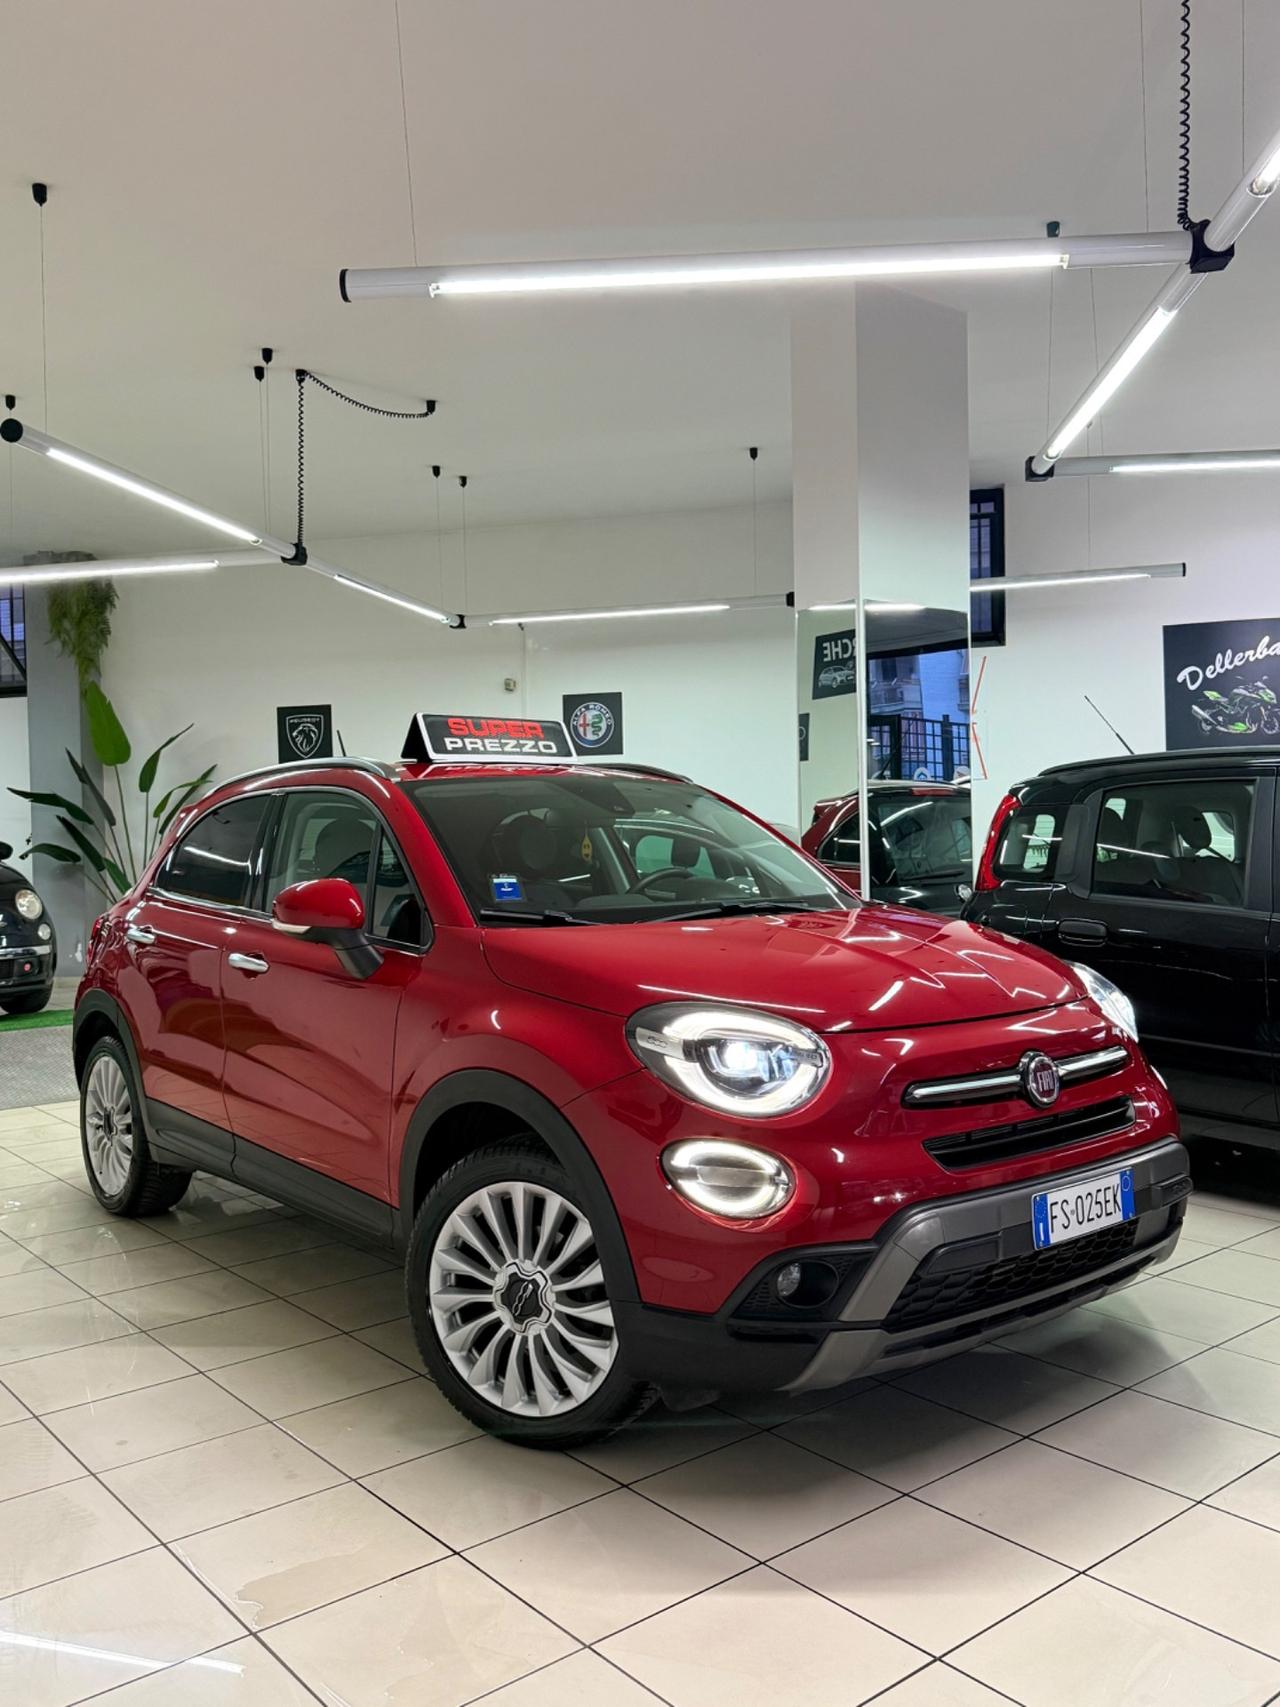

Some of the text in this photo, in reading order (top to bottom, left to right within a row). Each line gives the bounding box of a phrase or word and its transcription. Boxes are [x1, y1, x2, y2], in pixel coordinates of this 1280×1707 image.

[447, 718, 544, 738] SUPER
[444, 737, 557, 753] PREZZO
[1036, 1070, 1055, 1092] FIAT
